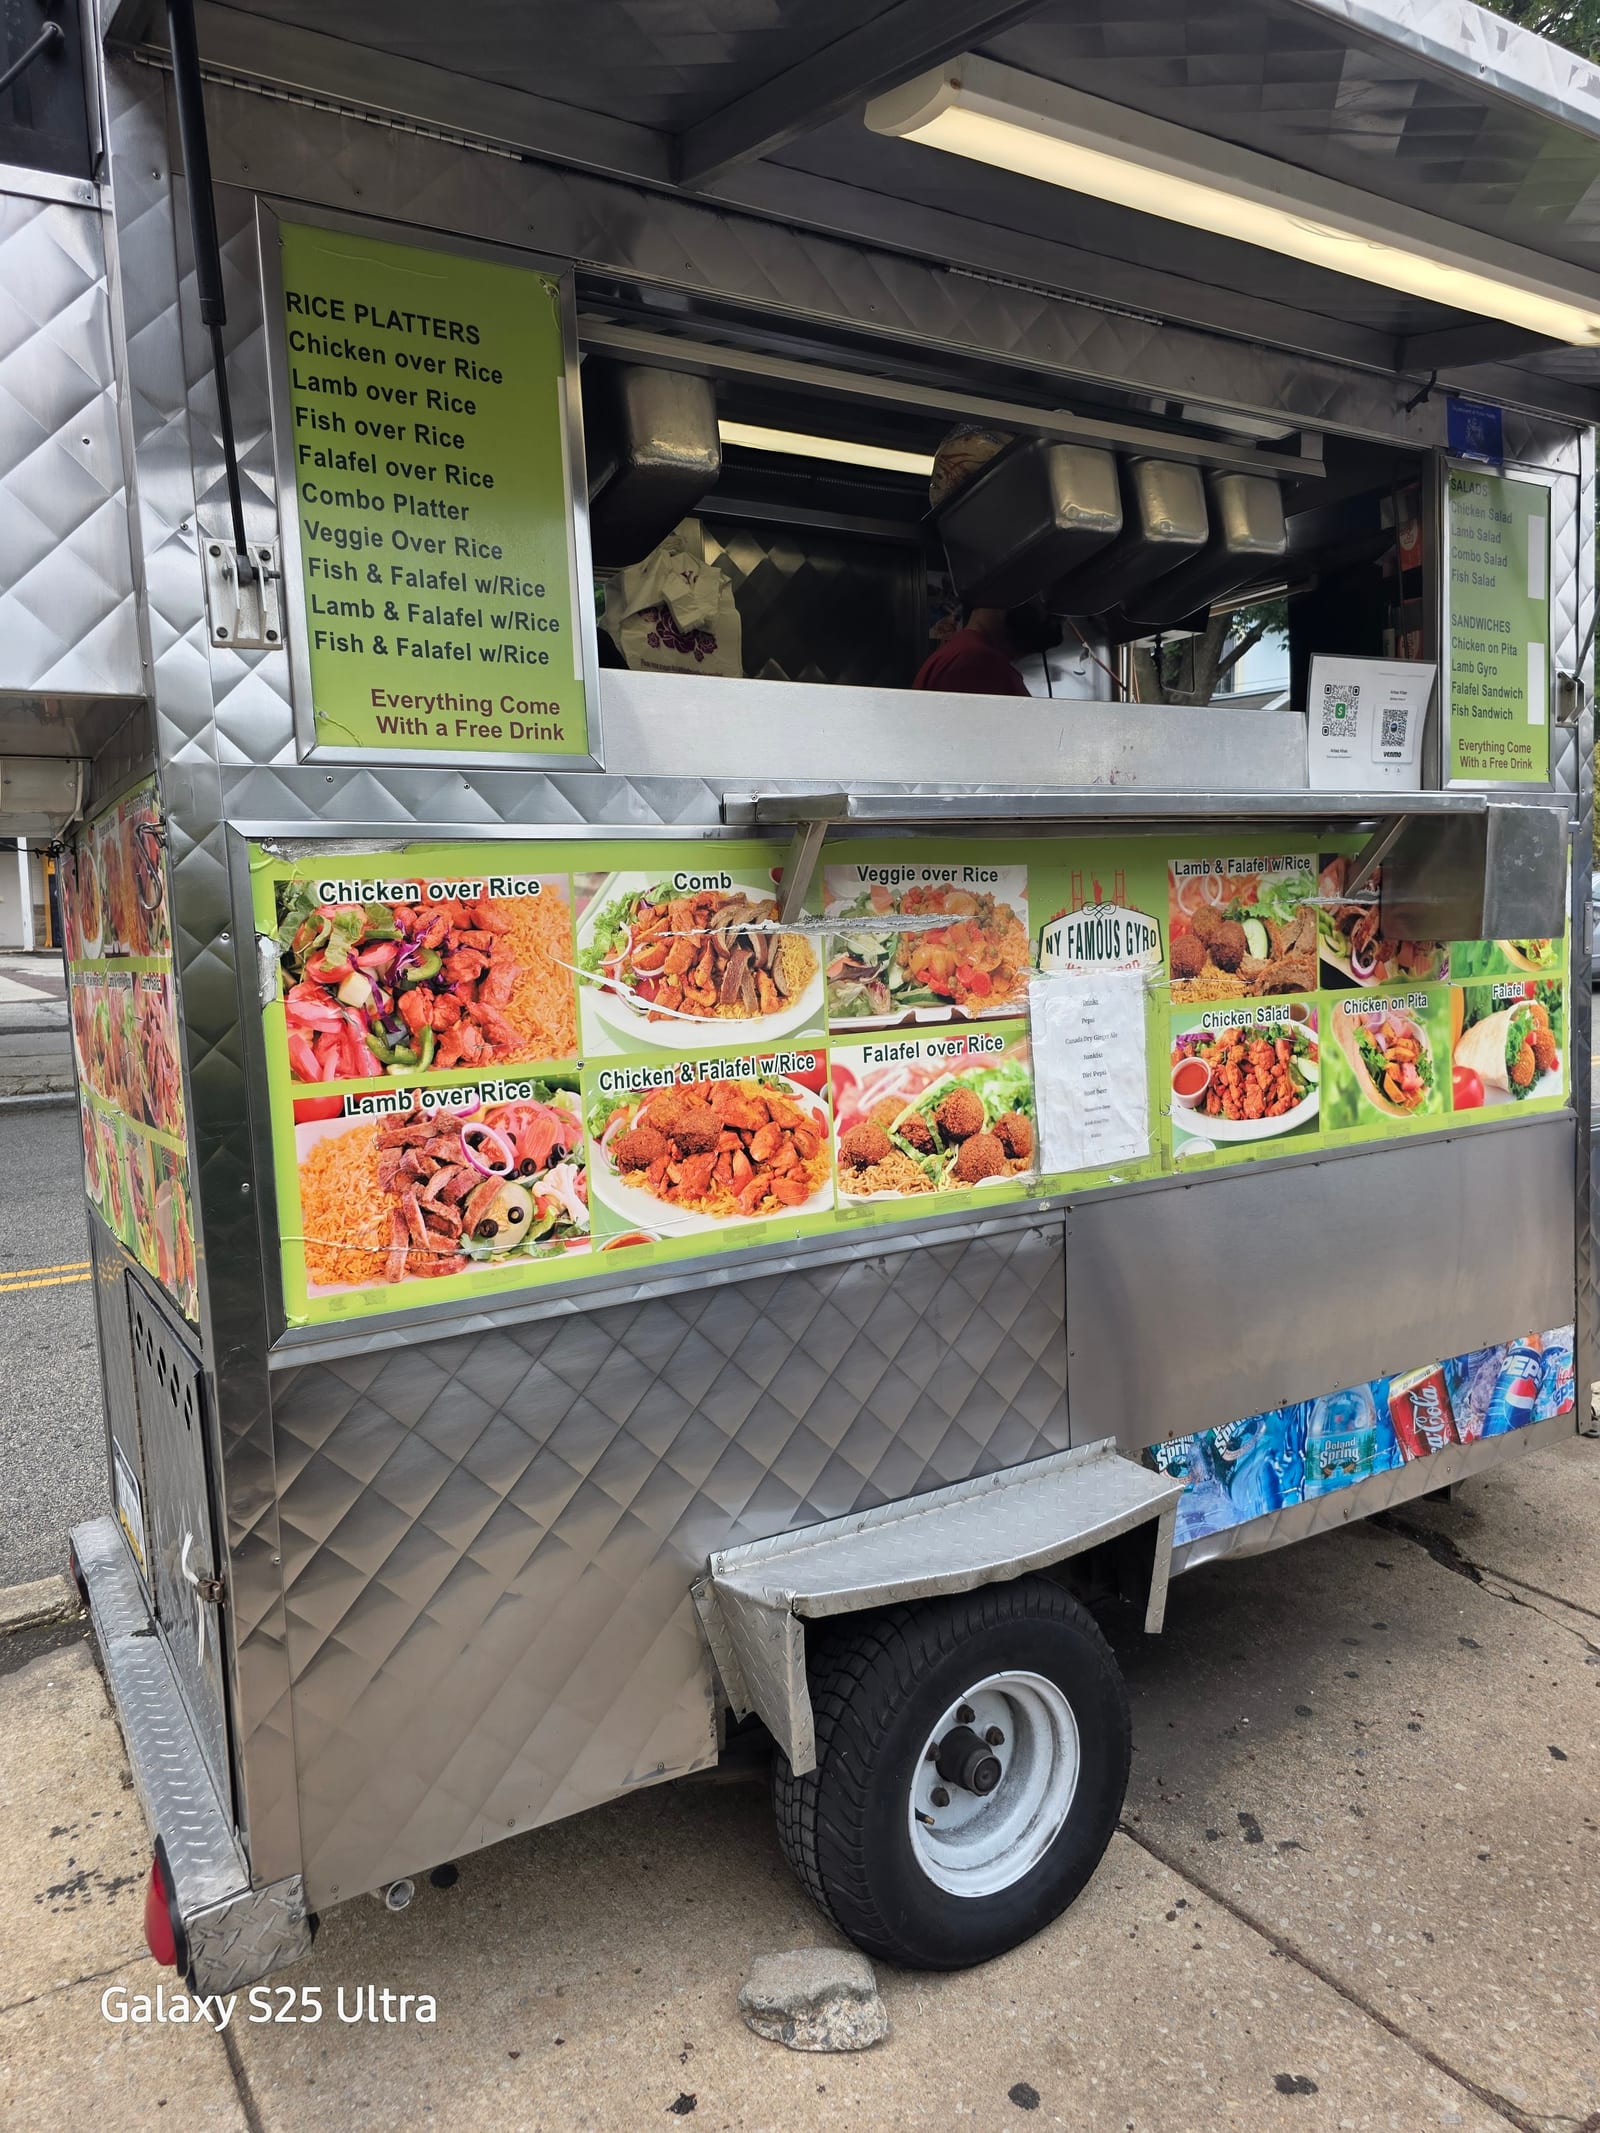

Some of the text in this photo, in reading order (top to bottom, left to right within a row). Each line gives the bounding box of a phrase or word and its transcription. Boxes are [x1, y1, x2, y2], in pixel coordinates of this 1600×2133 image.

[285, 291, 481, 346] RICE PLATTERS
[289, 330, 503, 384] Chicken over Rice
[292, 368, 477, 416] Lamb over Rice
[295, 406, 466, 450] Fish over Rice
[299, 444, 495, 489] Falafel over Rice
[1450, 478, 1488, 497] SALADS
[302, 482, 470, 521] Combo Platter
[1450, 501, 1513, 525] Chicken Salad
[304, 519, 503, 560] Veggie Over Rice
[1451, 523, 1502, 544] Lamb Salad
[1451, 546, 1508, 568] Combo Salad
[308, 556, 546, 598] Fish & Falafel w/Rice
[1451, 568, 1496, 588] Fish Salad
[311, 594, 560, 633] Lamb & Falafel w/Rice
[1451, 614, 1511, 634] SANDWICHES
[314, 630, 550, 666] Fish & Falafel w/Rice
[1451, 636, 1518, 656] Chicken on Pita
[1451, 659, 1498, 678] Lamb Gyro
[371, 688, 560, 717] Everything Come
[1451, 681, 1523, 700] Falafel Sandwich
[1451, 704, 1513, 720] Fish Sandwich
[376, 715, 565, 741] With a Free Drink
[1458, 739, 1532, 755] Everything Come
[1459, 755, 1533, 770] With a Free Drink
[857, 866, 999, 885] Veggie over Rice
[1174, 855, 1311, 876] Lamb & Falafel w/Rice
[318, 877, 541, 903] Chicken over Rice
[673, 871, 732, 892] Comb
[1045, 919, 1157, 960] NY FAMOUS GYRO
[1492, 983, 1525, 1000] Falafel
[1343, 993, 1428, 1015] Chicken on Pita
[1202, 1004, 1290, 1029] Chicken Salad
[863, 1035, 1004, 1064] Falafel over Rice
[598, 1052, 816, 1092] Chicken & Falafel w/Rice
[345, 1080, 532, 1117] Lamb over Rice
[1325, 1436, 1356, 1451] Poland
[1321, 1447, 1360, 1469] Spring
